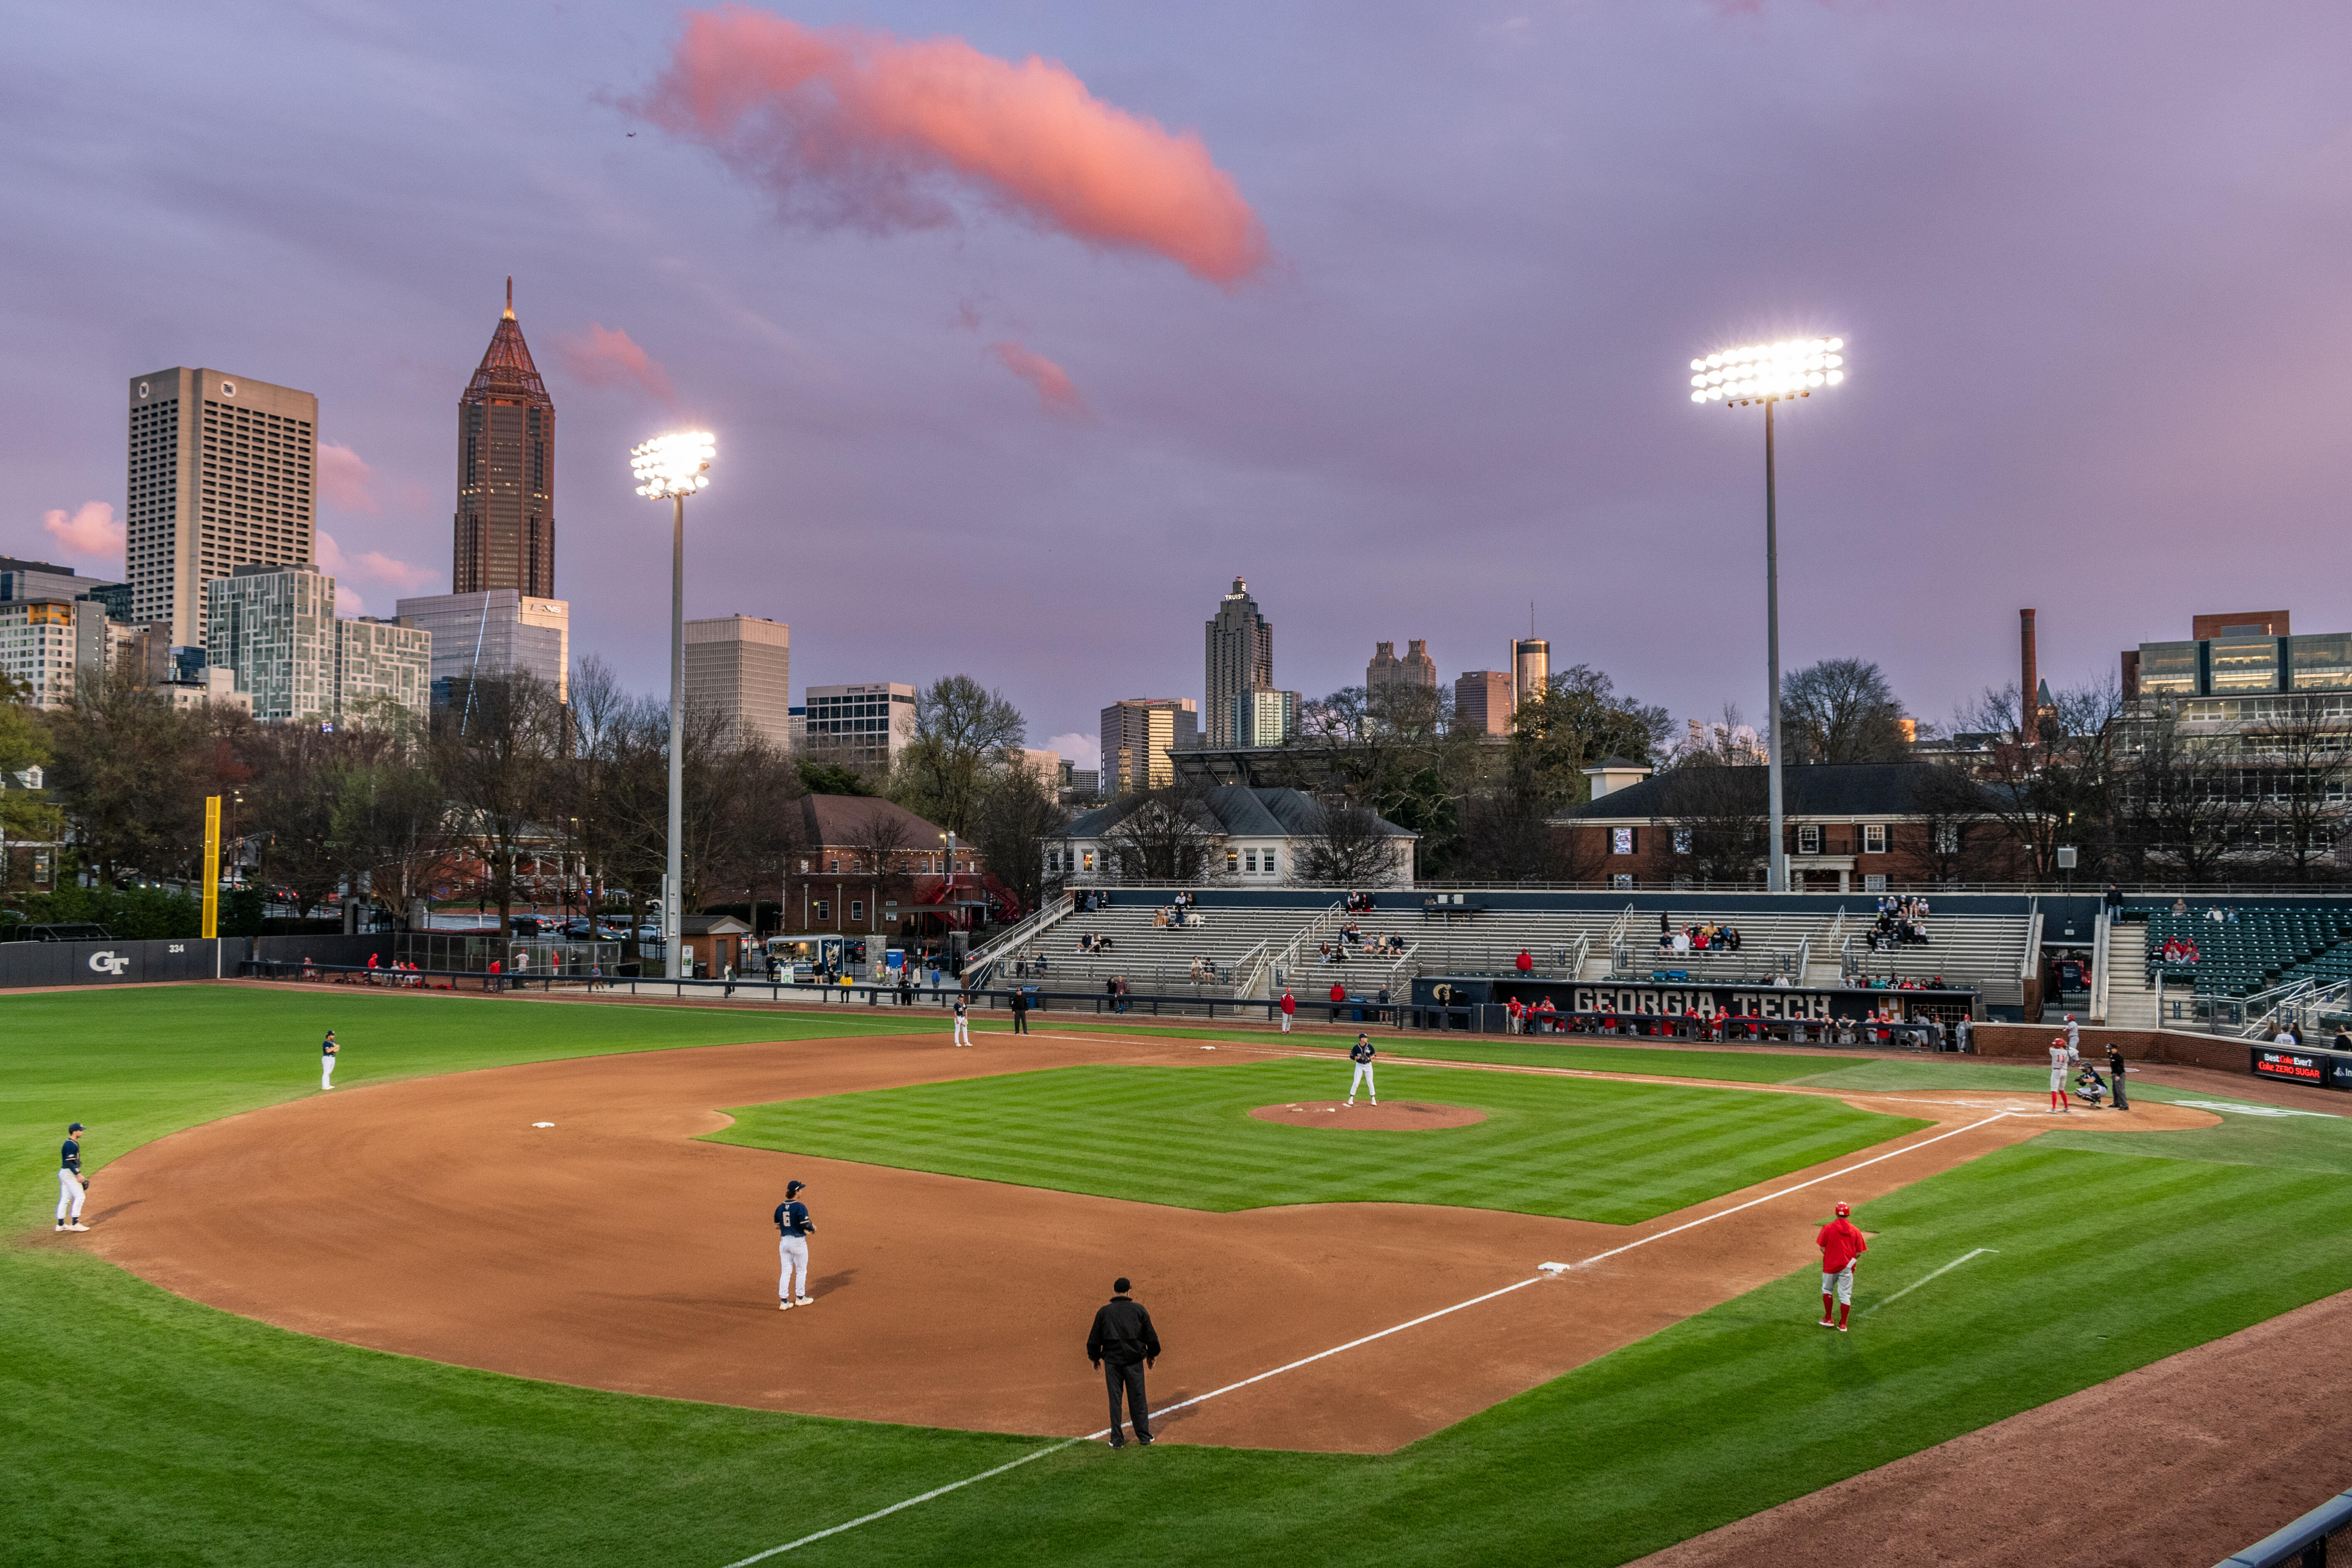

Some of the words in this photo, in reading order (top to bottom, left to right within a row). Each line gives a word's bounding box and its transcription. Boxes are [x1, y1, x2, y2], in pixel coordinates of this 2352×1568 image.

[169, 944, 184, 953] 334
[89, 951, 129, 975] GT
[1575, 988, 1716, 1019] GEORGIA
[1733, 993, 1831, 1020] TECH
[2057, 1054, 2065, 1063] 11
[2264, 1053, 2280, 1062] Best
[2280, 1055, 2294, 1064] Coke
[2293, 1057, 2312, 1067] Ever?
[2258, 1061, 2275, 1072] Coke
[2275, 1064, 2294, 1074] ZERO
[2295, 1067, 2320, 1078] SUGAR
[783, 1211, 790, 1227] 6
